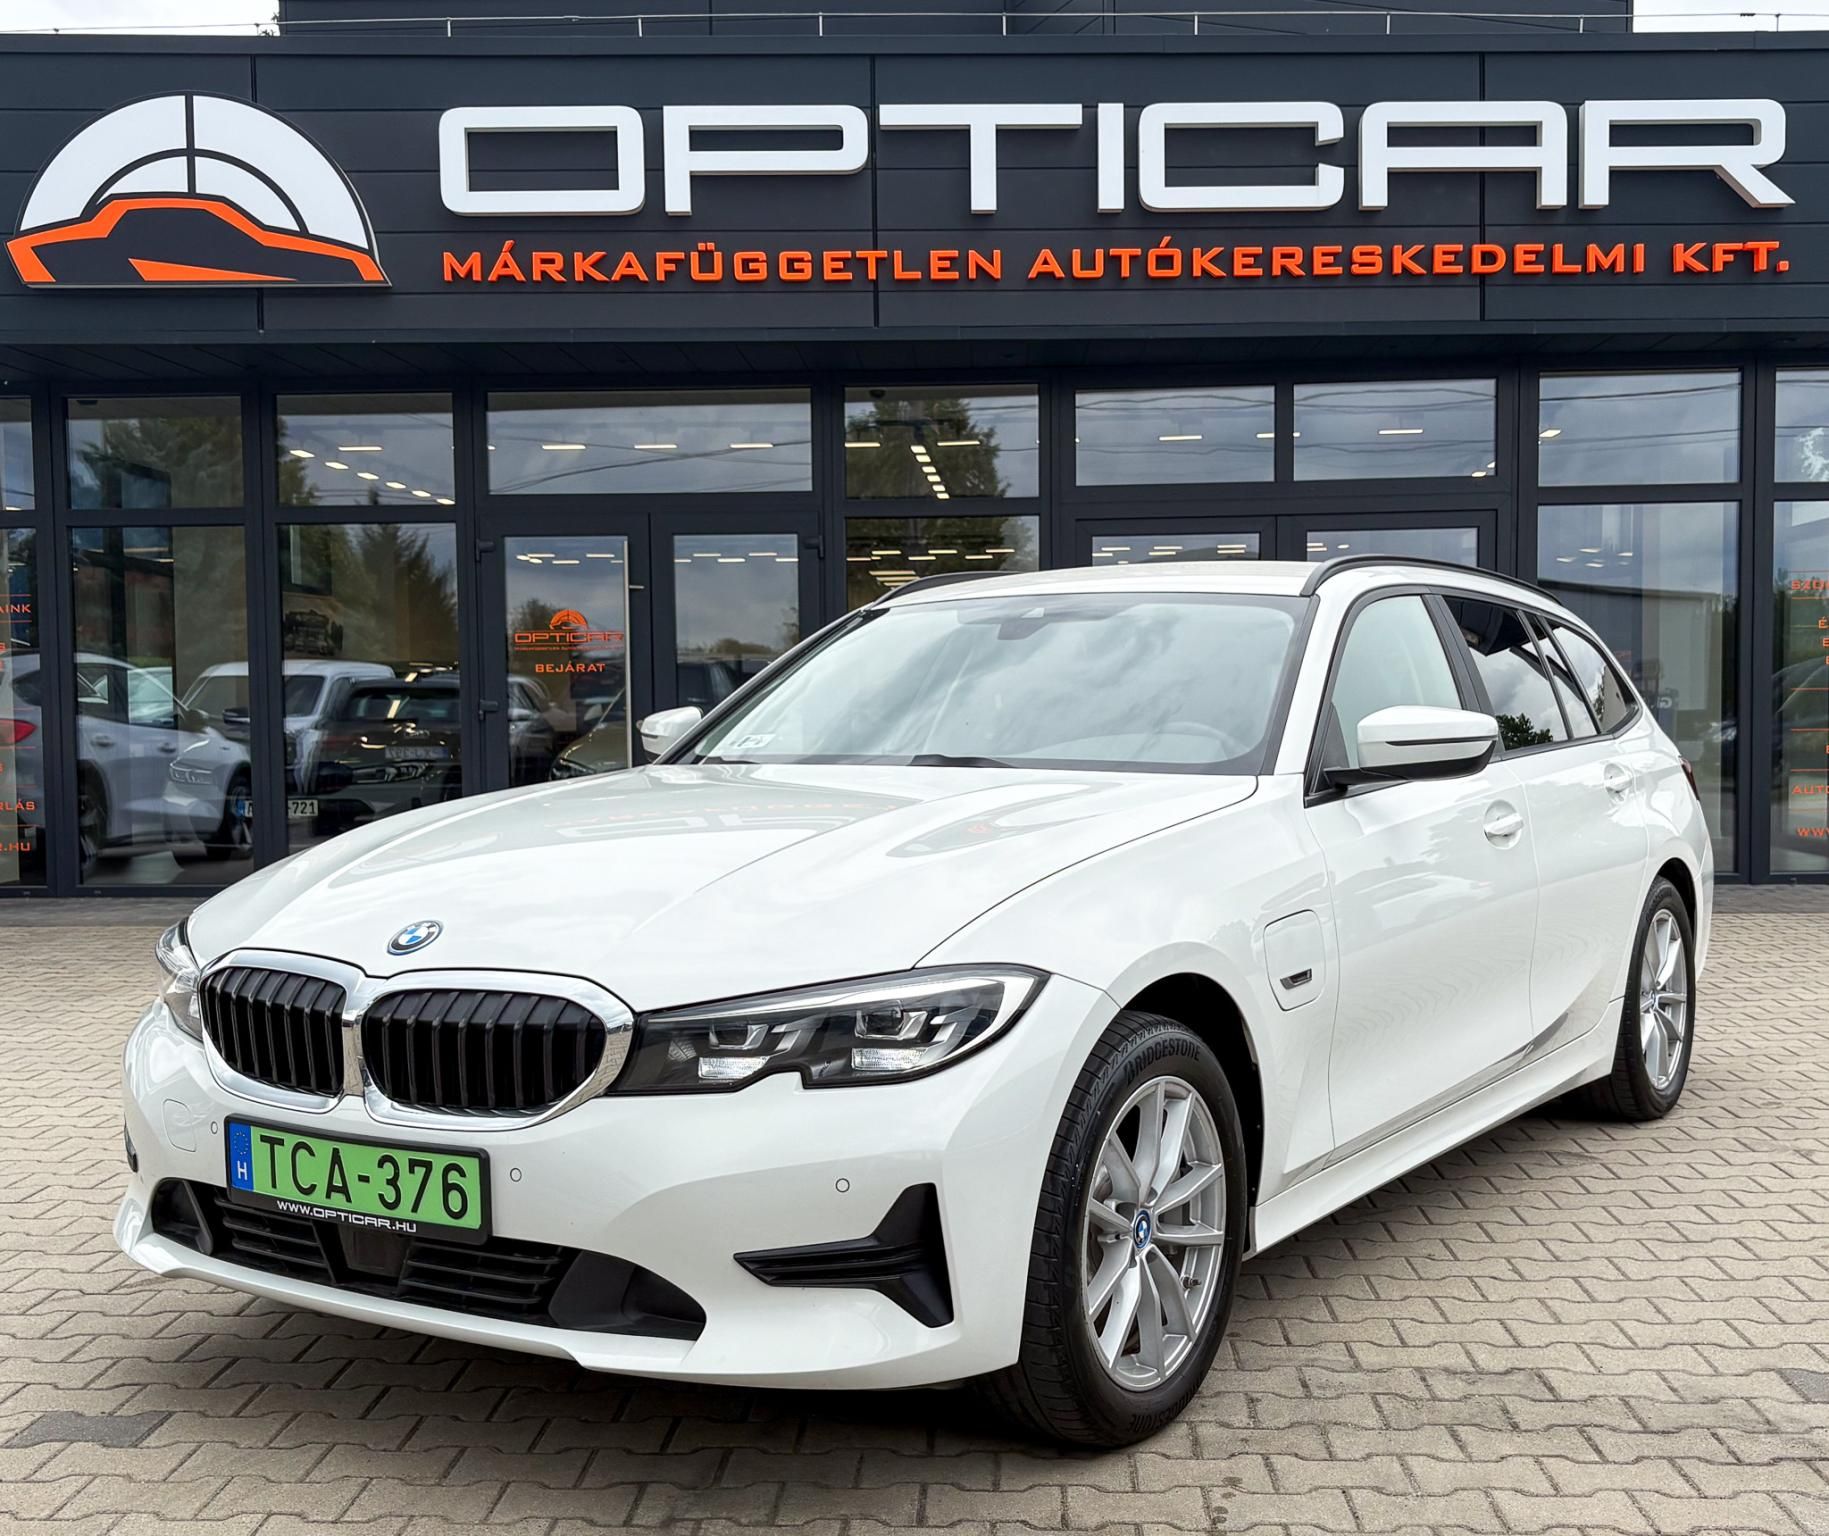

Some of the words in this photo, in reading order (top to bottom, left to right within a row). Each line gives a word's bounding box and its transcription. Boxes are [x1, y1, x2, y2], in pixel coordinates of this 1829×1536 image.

[438, 98, 1795, 216] OPTICAR
[442, 239, 1002, 283] MÁRKAFÜGGETLEN
[1028, 235, 1646, 280] AUTÓKERESKEDELMI
[1673, 240, 1791, 274] KFT.
[513, 631, 625, 643] OPTICAR
[535, 661, 606, 673] BEJÁRAT
[1124, 1037, 1201, 1086] BRIDGESTONE
[237, 1160, 249, 1181] H
[259, 1133, 469, 1220] TCA-376
[276, 1199, 417, 1233] WWW.OPTICAR.HU
